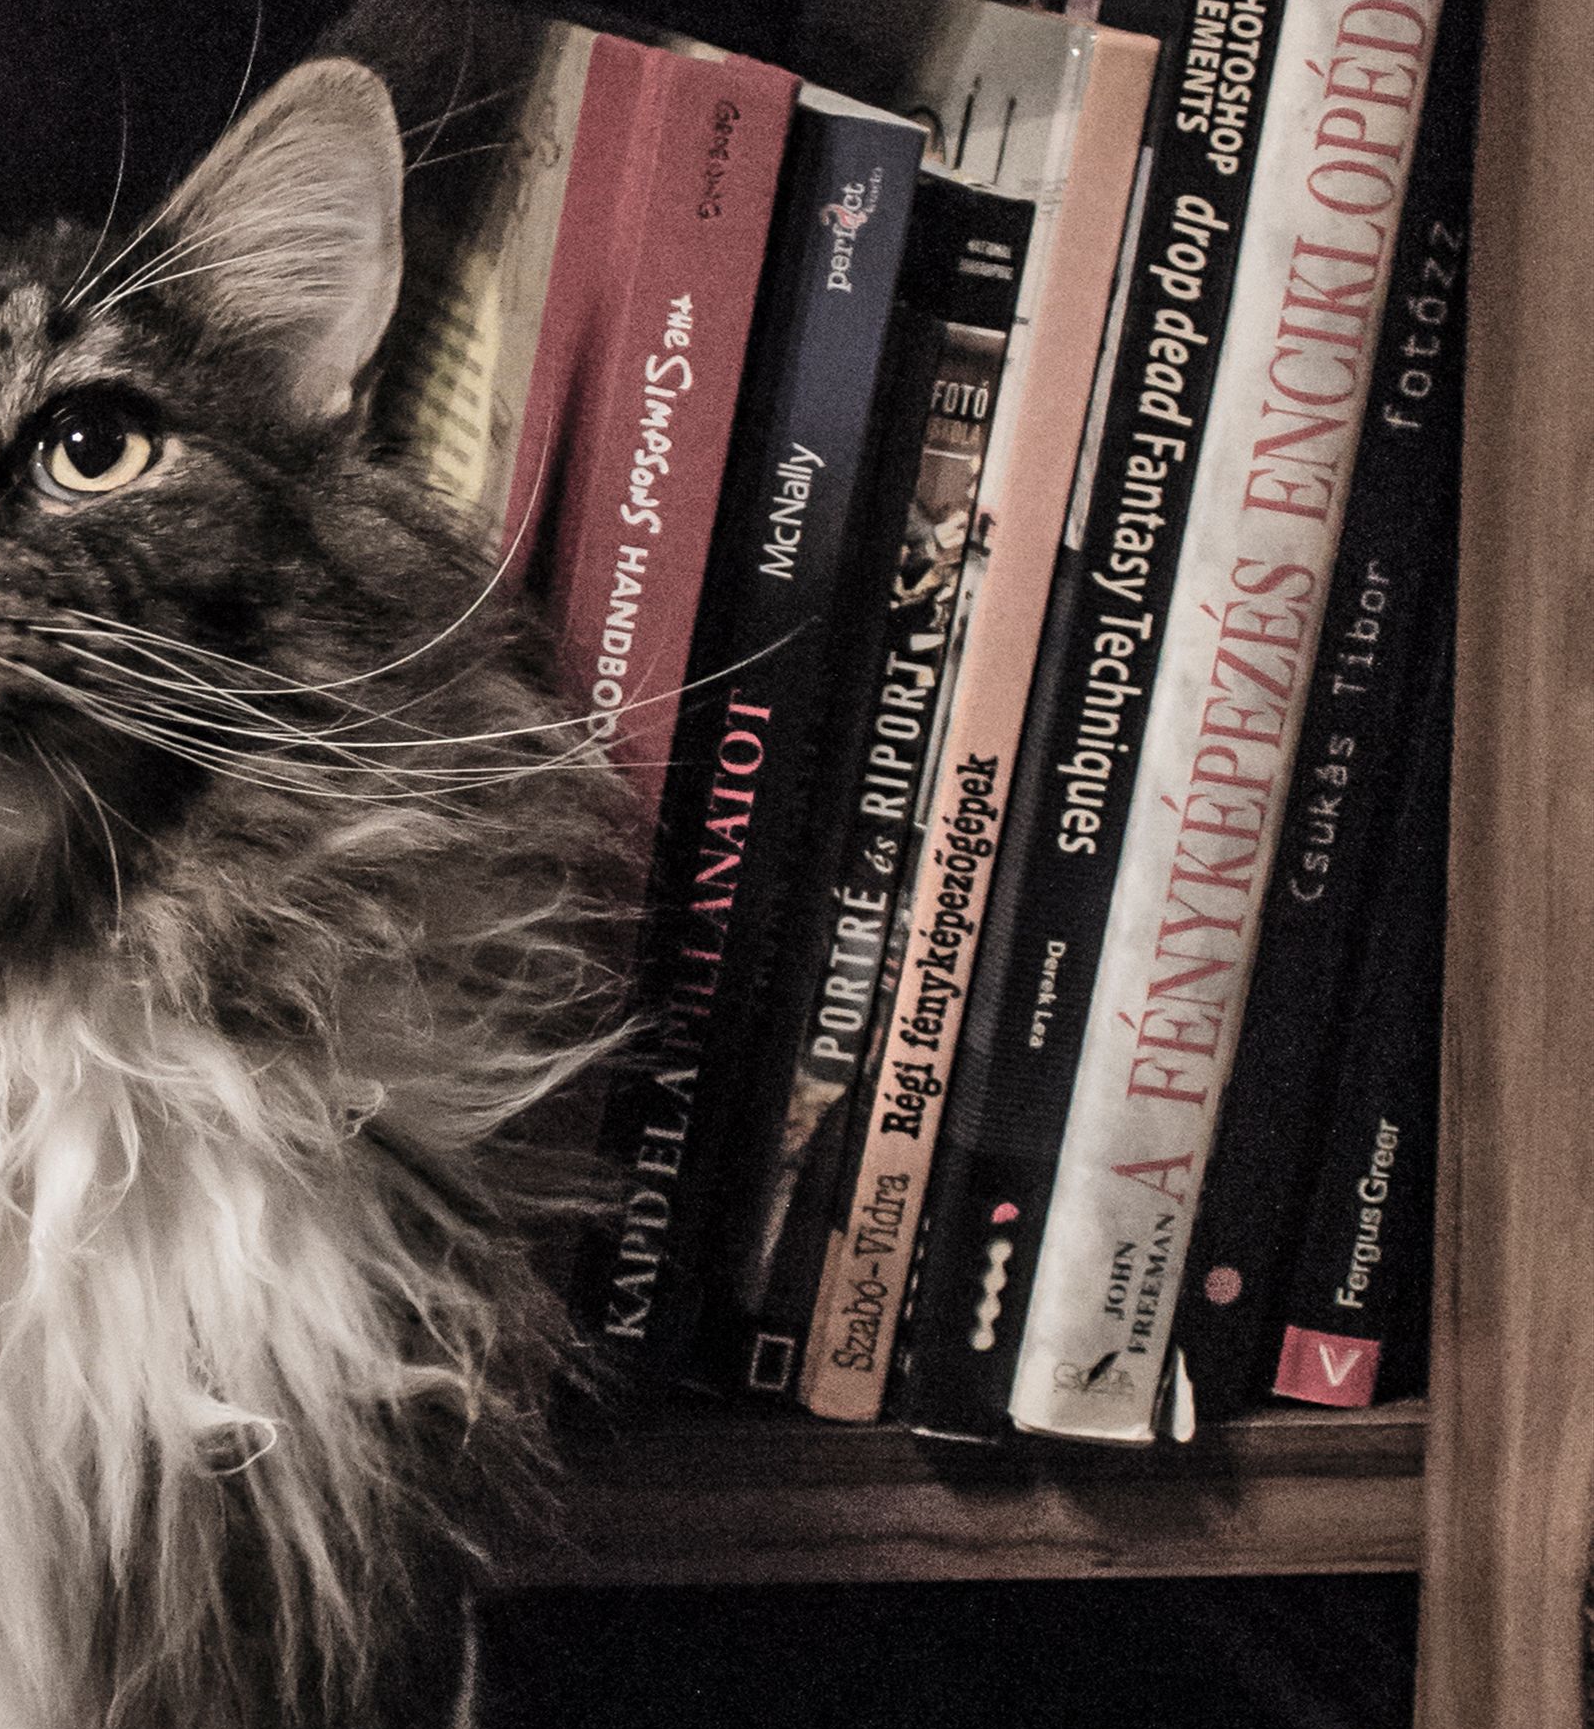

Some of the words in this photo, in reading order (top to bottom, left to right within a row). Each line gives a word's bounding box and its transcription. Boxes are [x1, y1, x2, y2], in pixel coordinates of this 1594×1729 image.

[1148, 194, 1231, 303] drop
[620, 353, 694, 536] SIMPSONS
[930, 379, 991, 421] FOTÓ
[1138, 308, 1209, 428] dead
[758, 442, 829, 582] McNally
[1091, 432, 1187, 604] Fantasy
[1057, 614, 1153, 858] Techniques
[1290, 733, 1357, 903] Csukás
[1330, 558, 1394, 695] Tibor
[812, 884, 889, 1065] PORTRÉ
[860, 651, 934, 820] RIPORT
[1116, 556, 1316, 1106] FÉNYKÉPEZÉS
[909, 751, 1000, 1070] fényképezőgépek
[880, 1071, 944, 1140] Régi
[1110, 1150, 1195, 1206] A
[832, 1170, 912, 1373] Szabó-Vidra
[1105, 1240, 1139, 1320] JOHN
[1126, 1212, 1176, 1356] FREEMAN
[1334, 1207, 1388, 1310] Fergus
